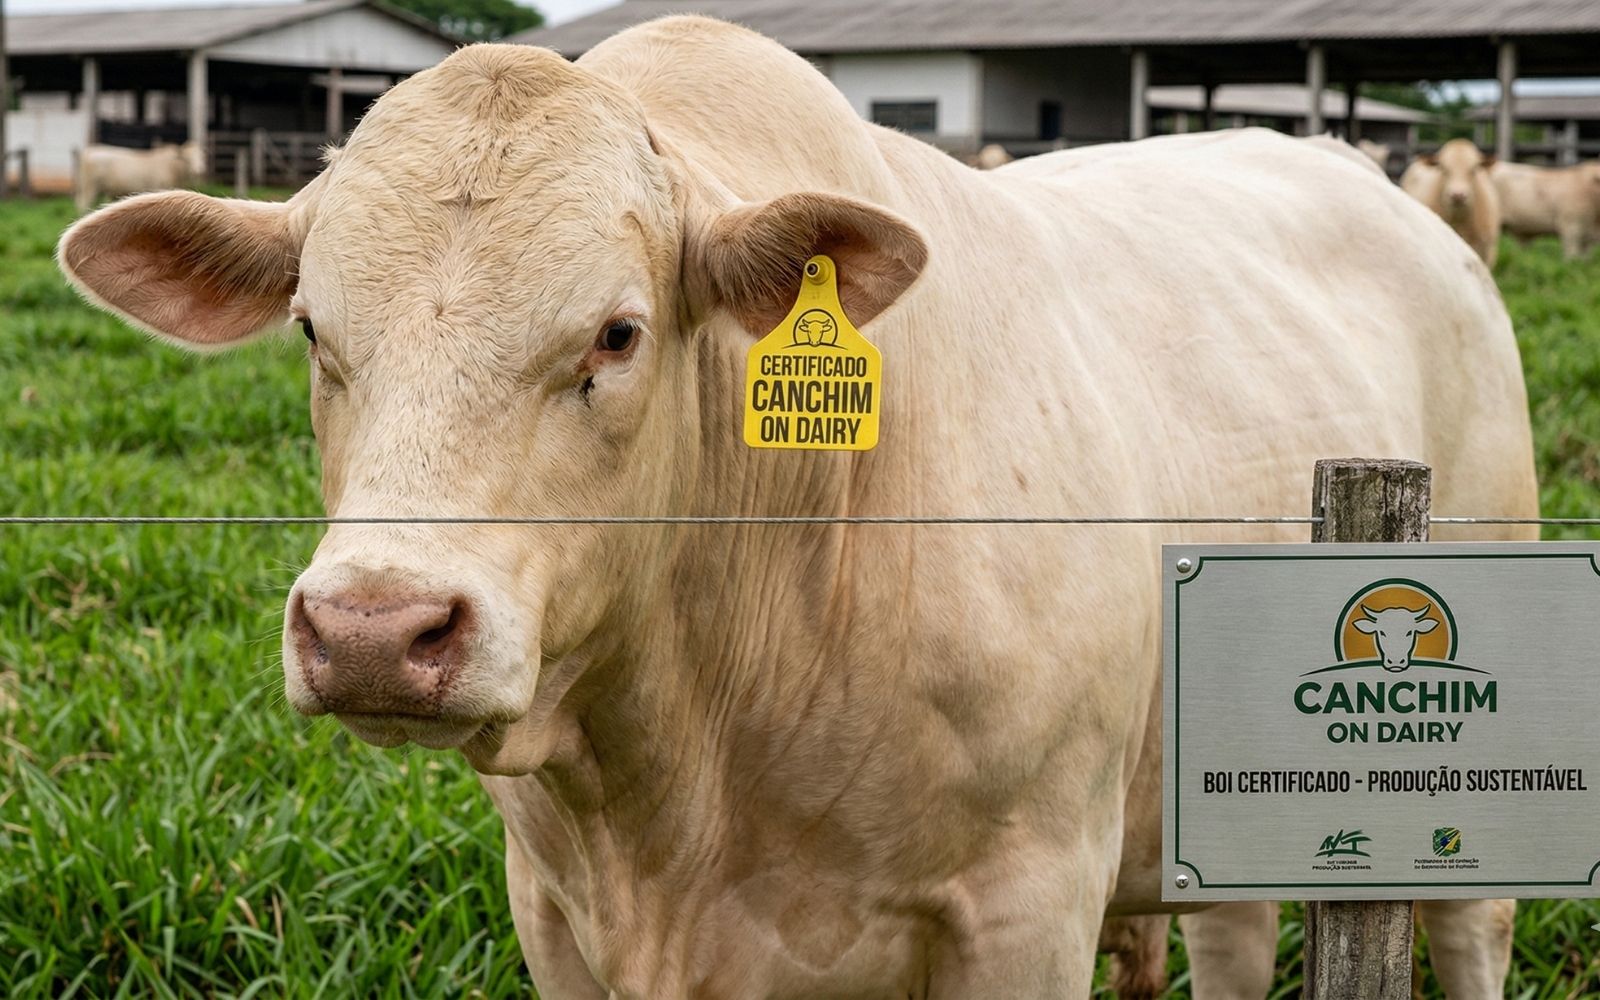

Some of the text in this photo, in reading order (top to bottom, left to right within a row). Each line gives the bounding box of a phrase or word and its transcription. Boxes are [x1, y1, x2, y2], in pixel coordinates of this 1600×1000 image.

[761, 355, 867, 377] CERTIFICADO
[752, 379, 873, 414] CANCHIM
[760, 415, 861, 445] ON DAIRY
[1294, 681, 1497, 714] CANCHIM
[1327, 721, 1463, 743] ON DAIRY
[1203, 771, 1233, 793] BOI
[1238, 771, 1350, 793] CERTIFICADO
[1368, 766, 1461, 797] PRODUÇÃO
[1466, 764, 1587, 792] SUSTENTÁVEL
